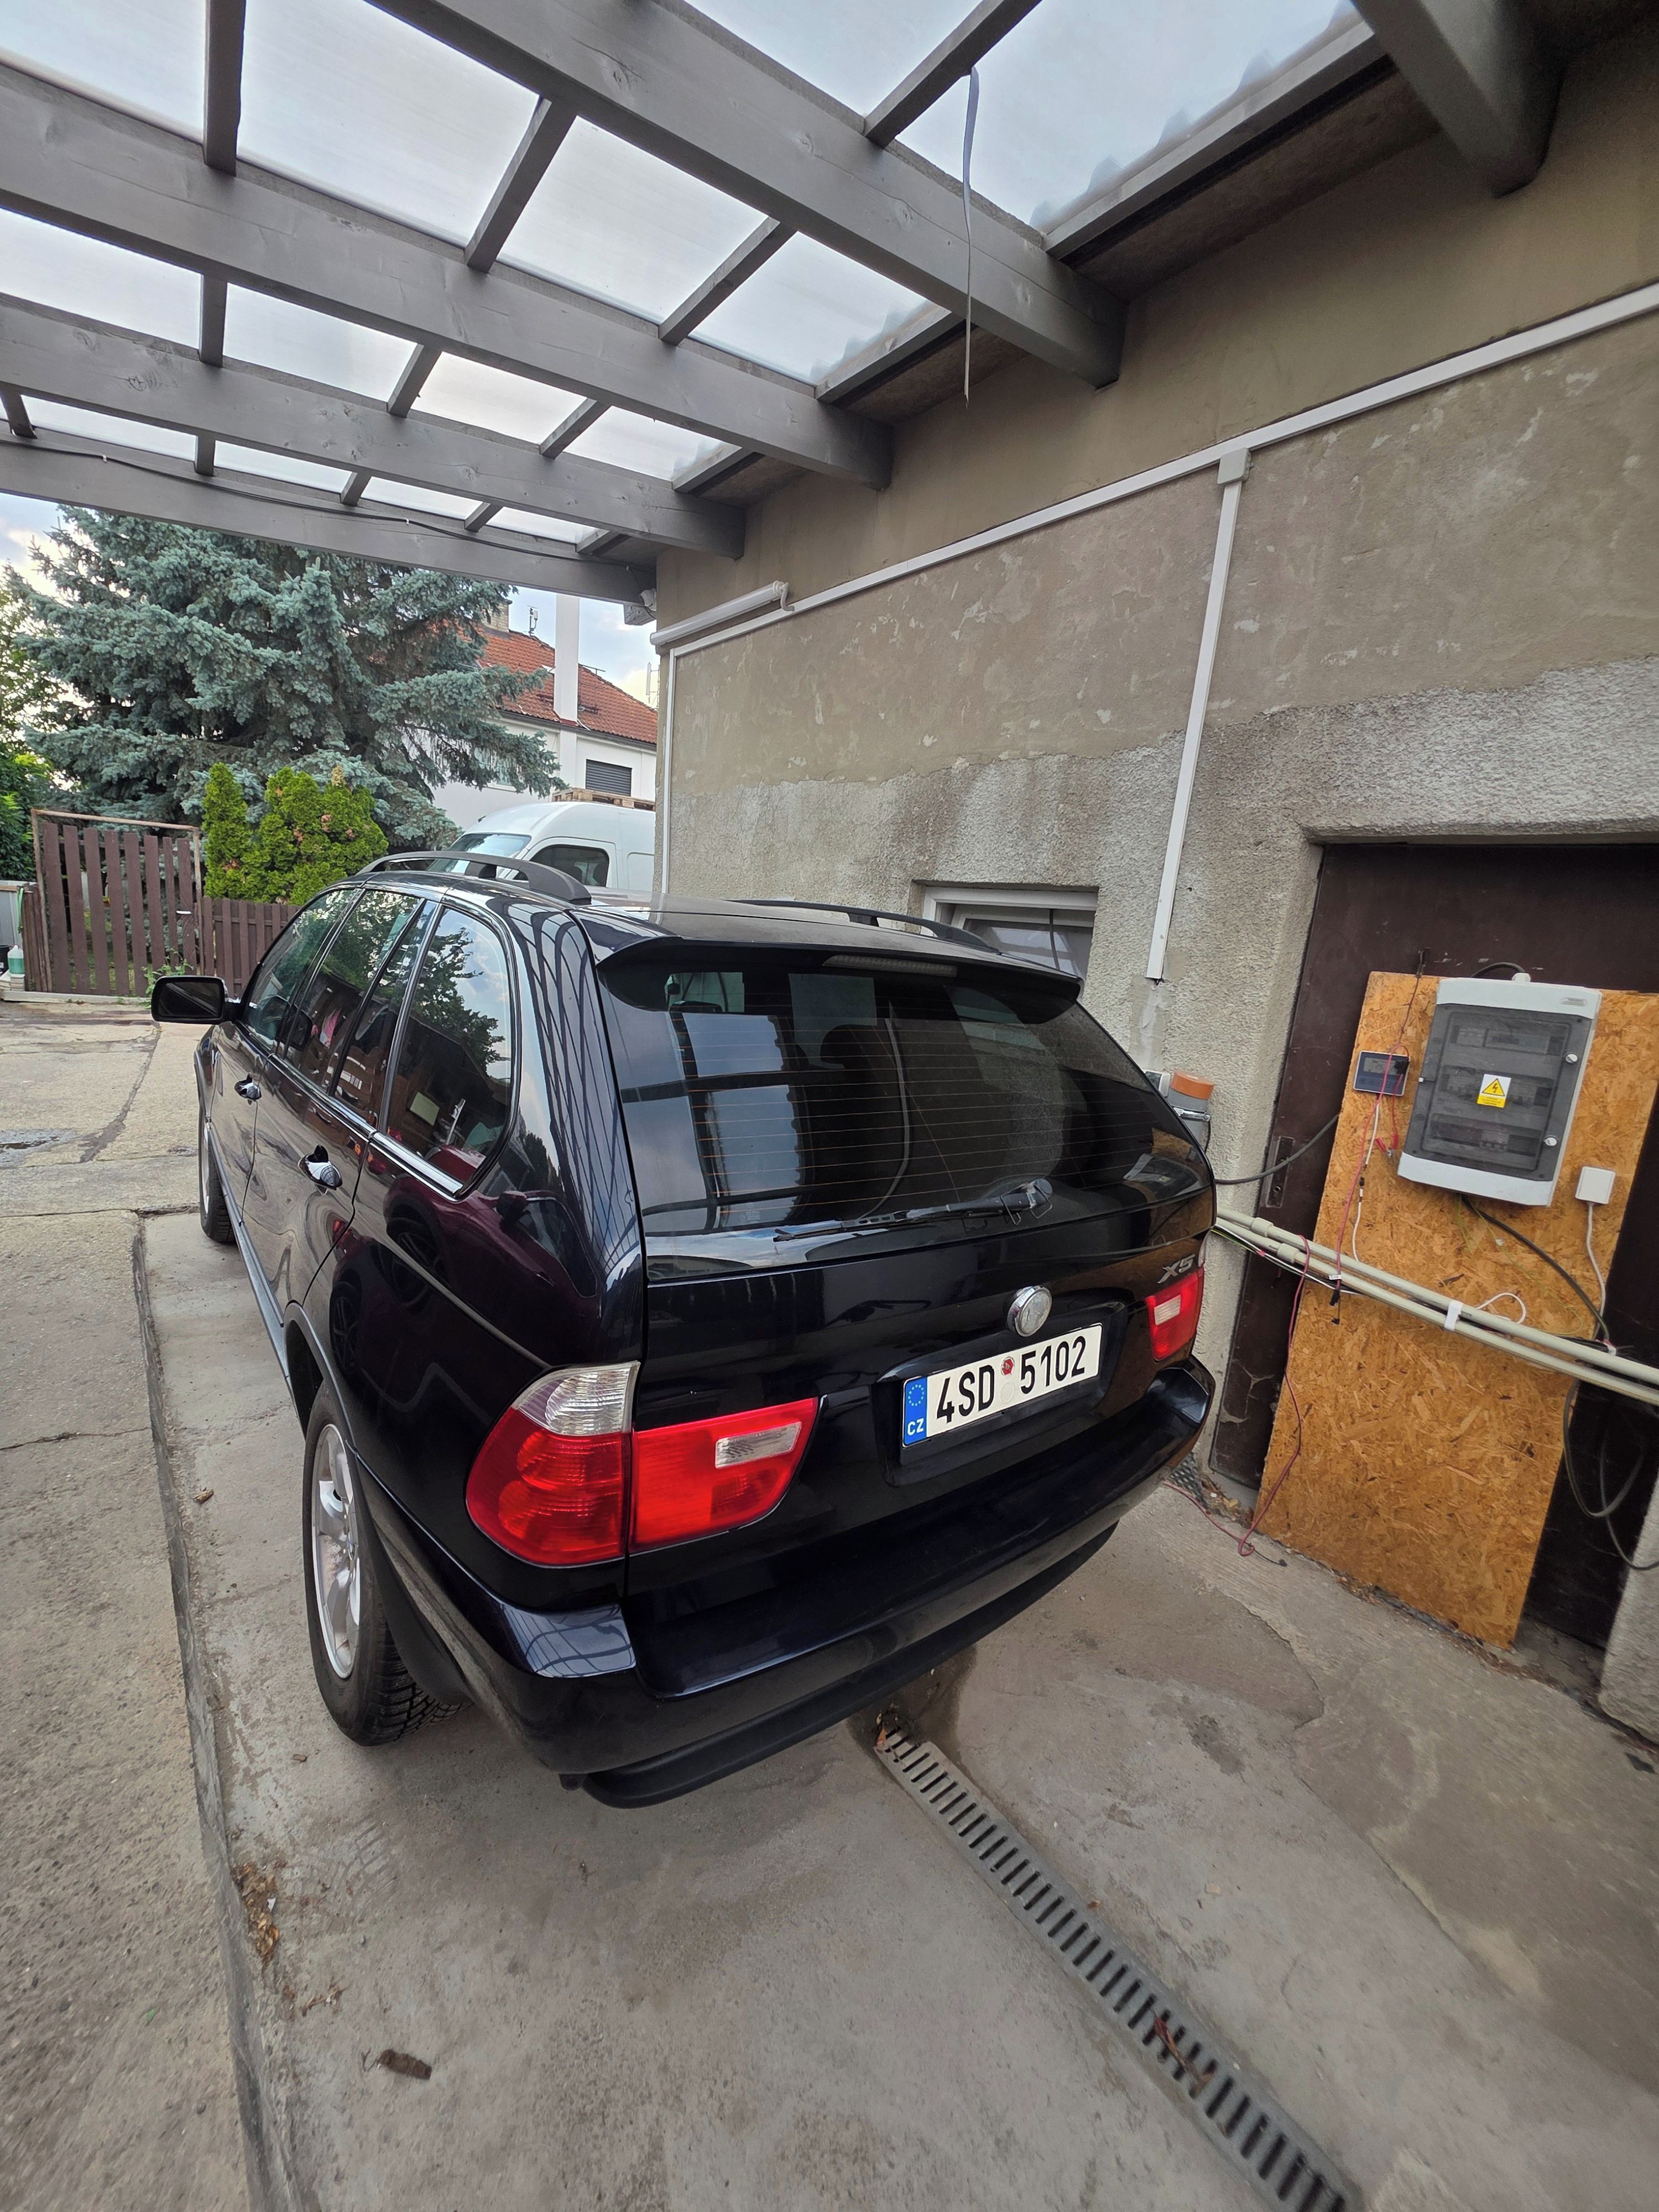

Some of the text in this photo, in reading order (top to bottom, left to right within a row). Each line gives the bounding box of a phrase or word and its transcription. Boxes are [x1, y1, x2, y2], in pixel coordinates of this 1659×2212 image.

[1157, 1254, 1196, 1283] X5
[937, 1336, 1086, 1423] 4SD 5102
[907, 1418, 924, 1436] CZ
